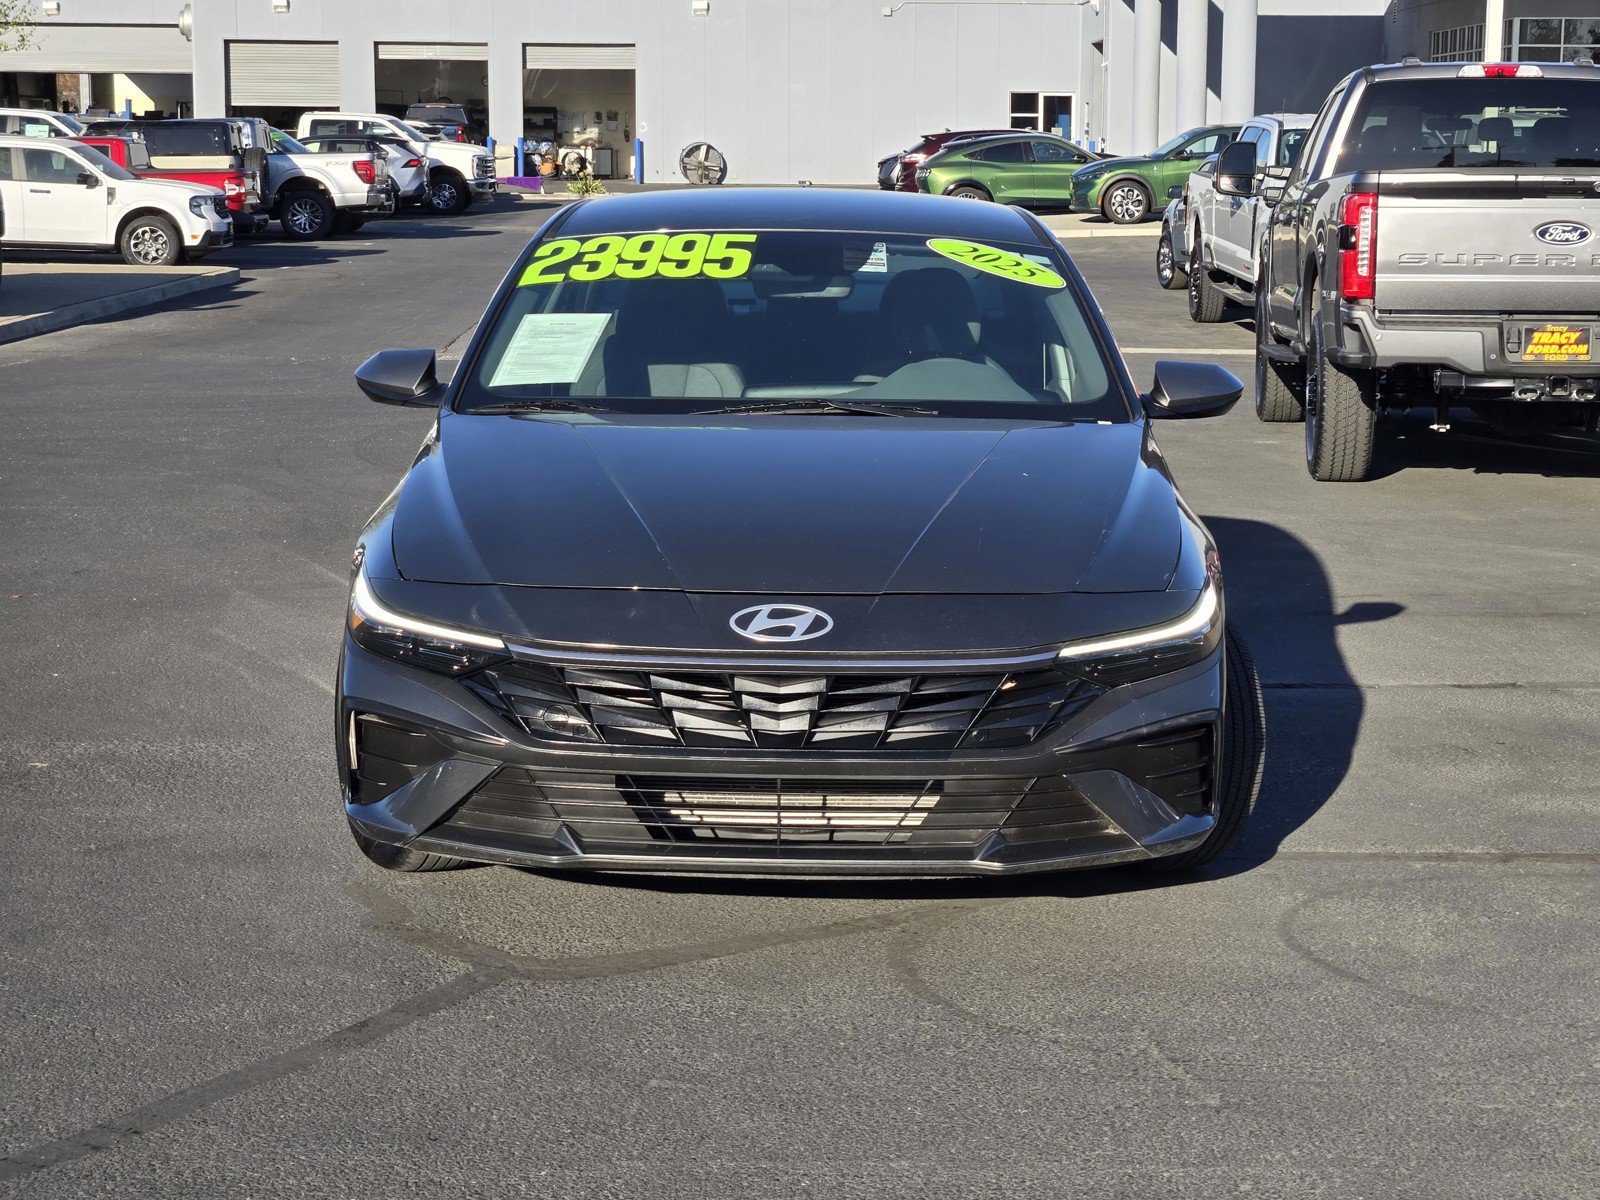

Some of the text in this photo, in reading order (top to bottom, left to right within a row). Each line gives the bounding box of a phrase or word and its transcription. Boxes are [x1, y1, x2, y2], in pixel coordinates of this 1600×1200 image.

[1545, 226, 1582, 241] Ford
[518, 233, 757, 286] 23995
[947, 245, 1047, 277] 2025
[1398, 253, 1576, 267] SUPER
[1545, 324, 1569, 333] Tracy
[1530, 331, 1582, 344] TRACY
[1525, 344, 1589, 354] FORD.COM
